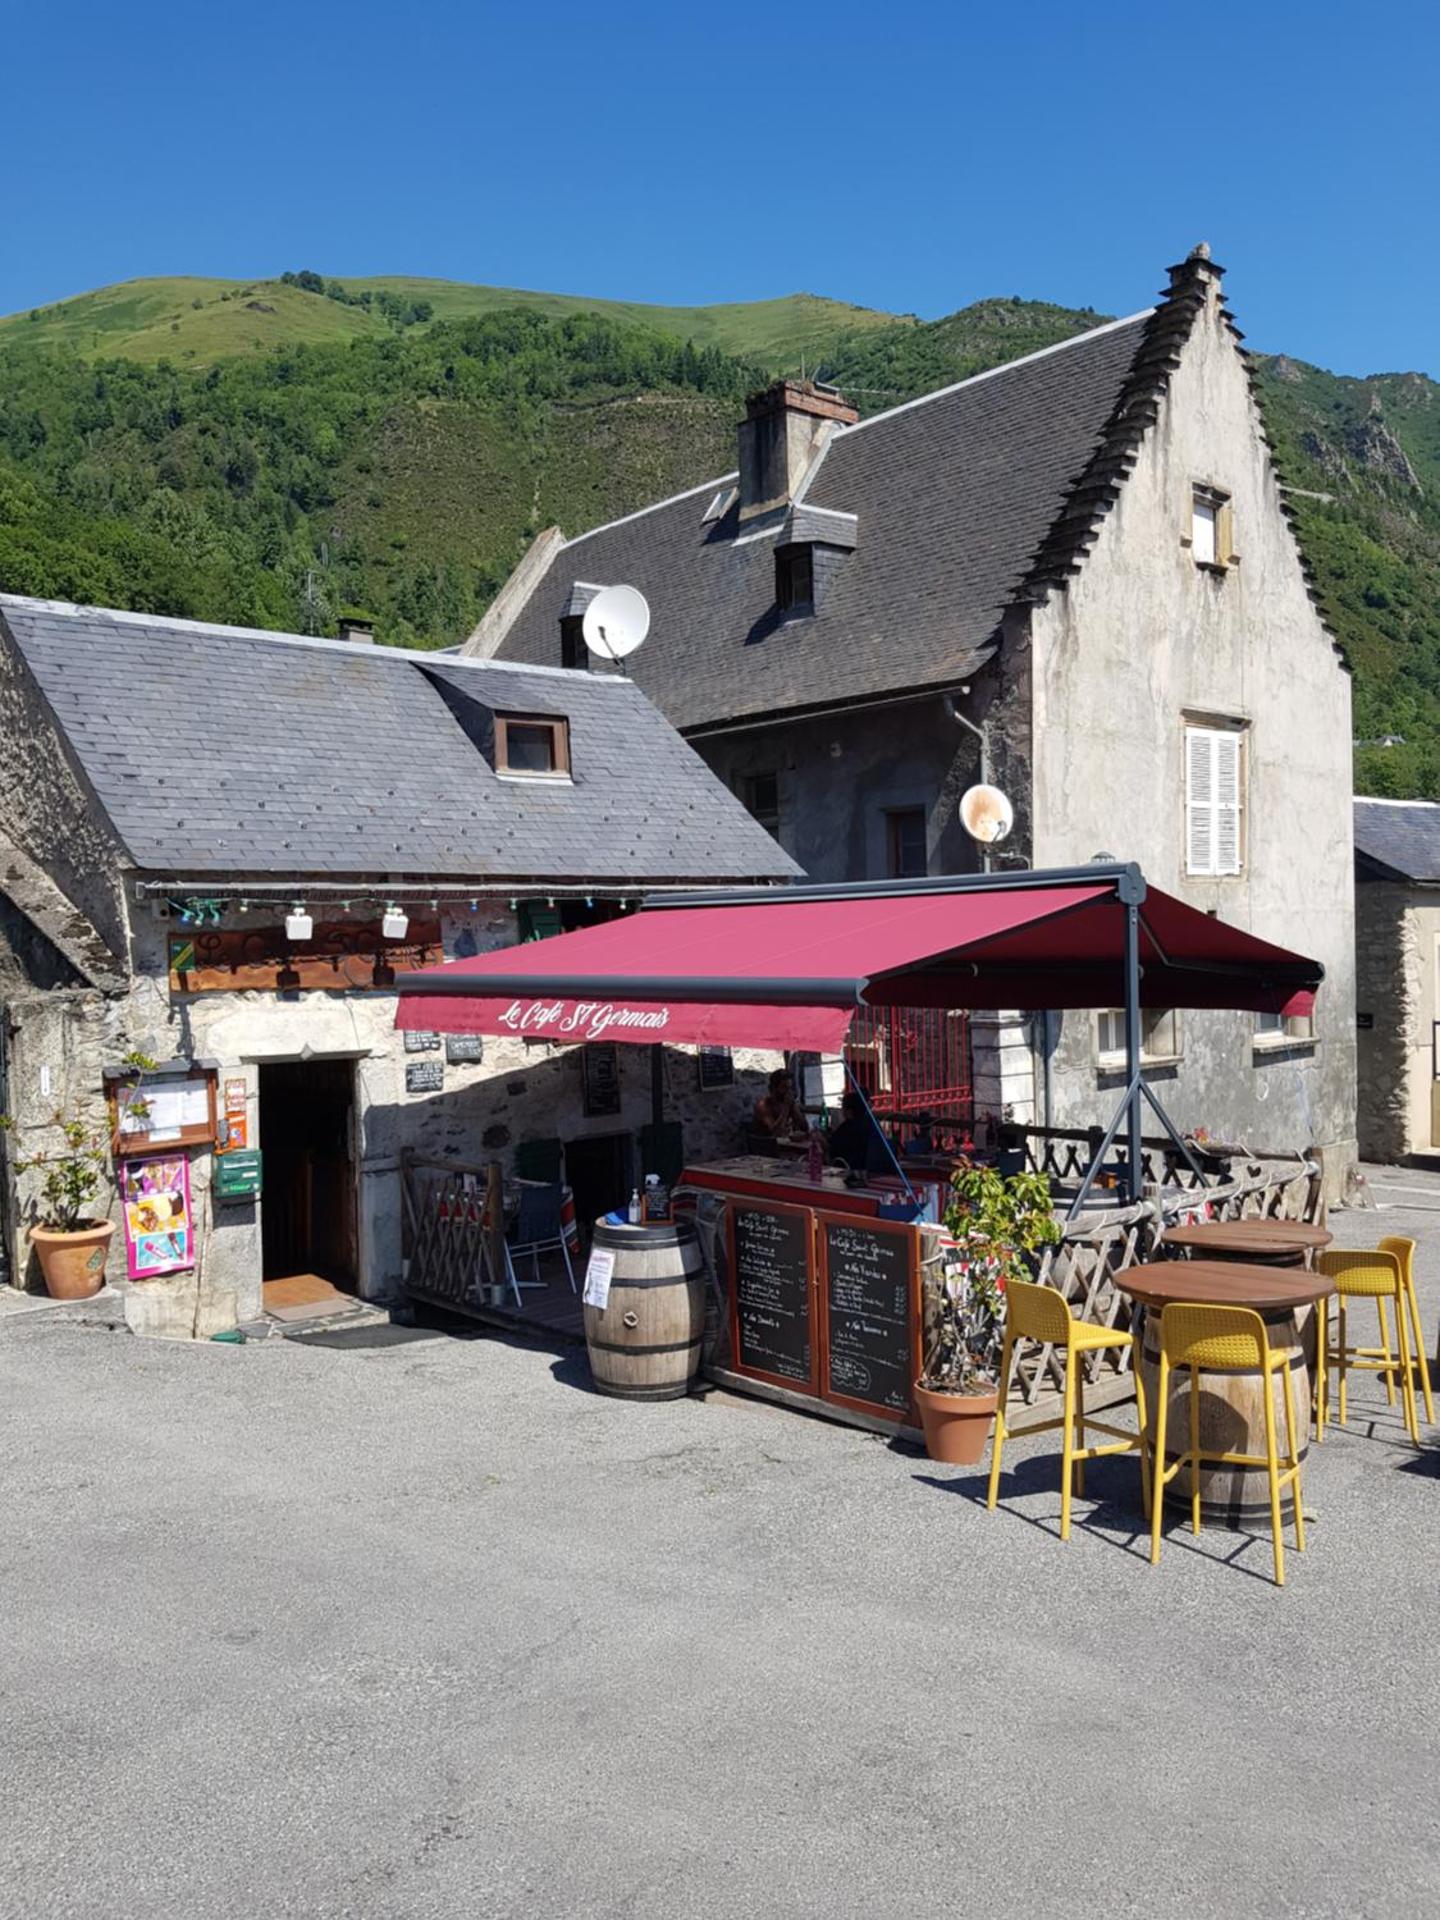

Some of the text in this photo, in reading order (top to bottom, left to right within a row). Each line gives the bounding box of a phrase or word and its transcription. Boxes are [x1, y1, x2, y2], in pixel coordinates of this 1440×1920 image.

[498, 1000, 521, 1029] Le
[520, 1001, 565, 1030] Café
[559, 1003, 600, 1031] St
